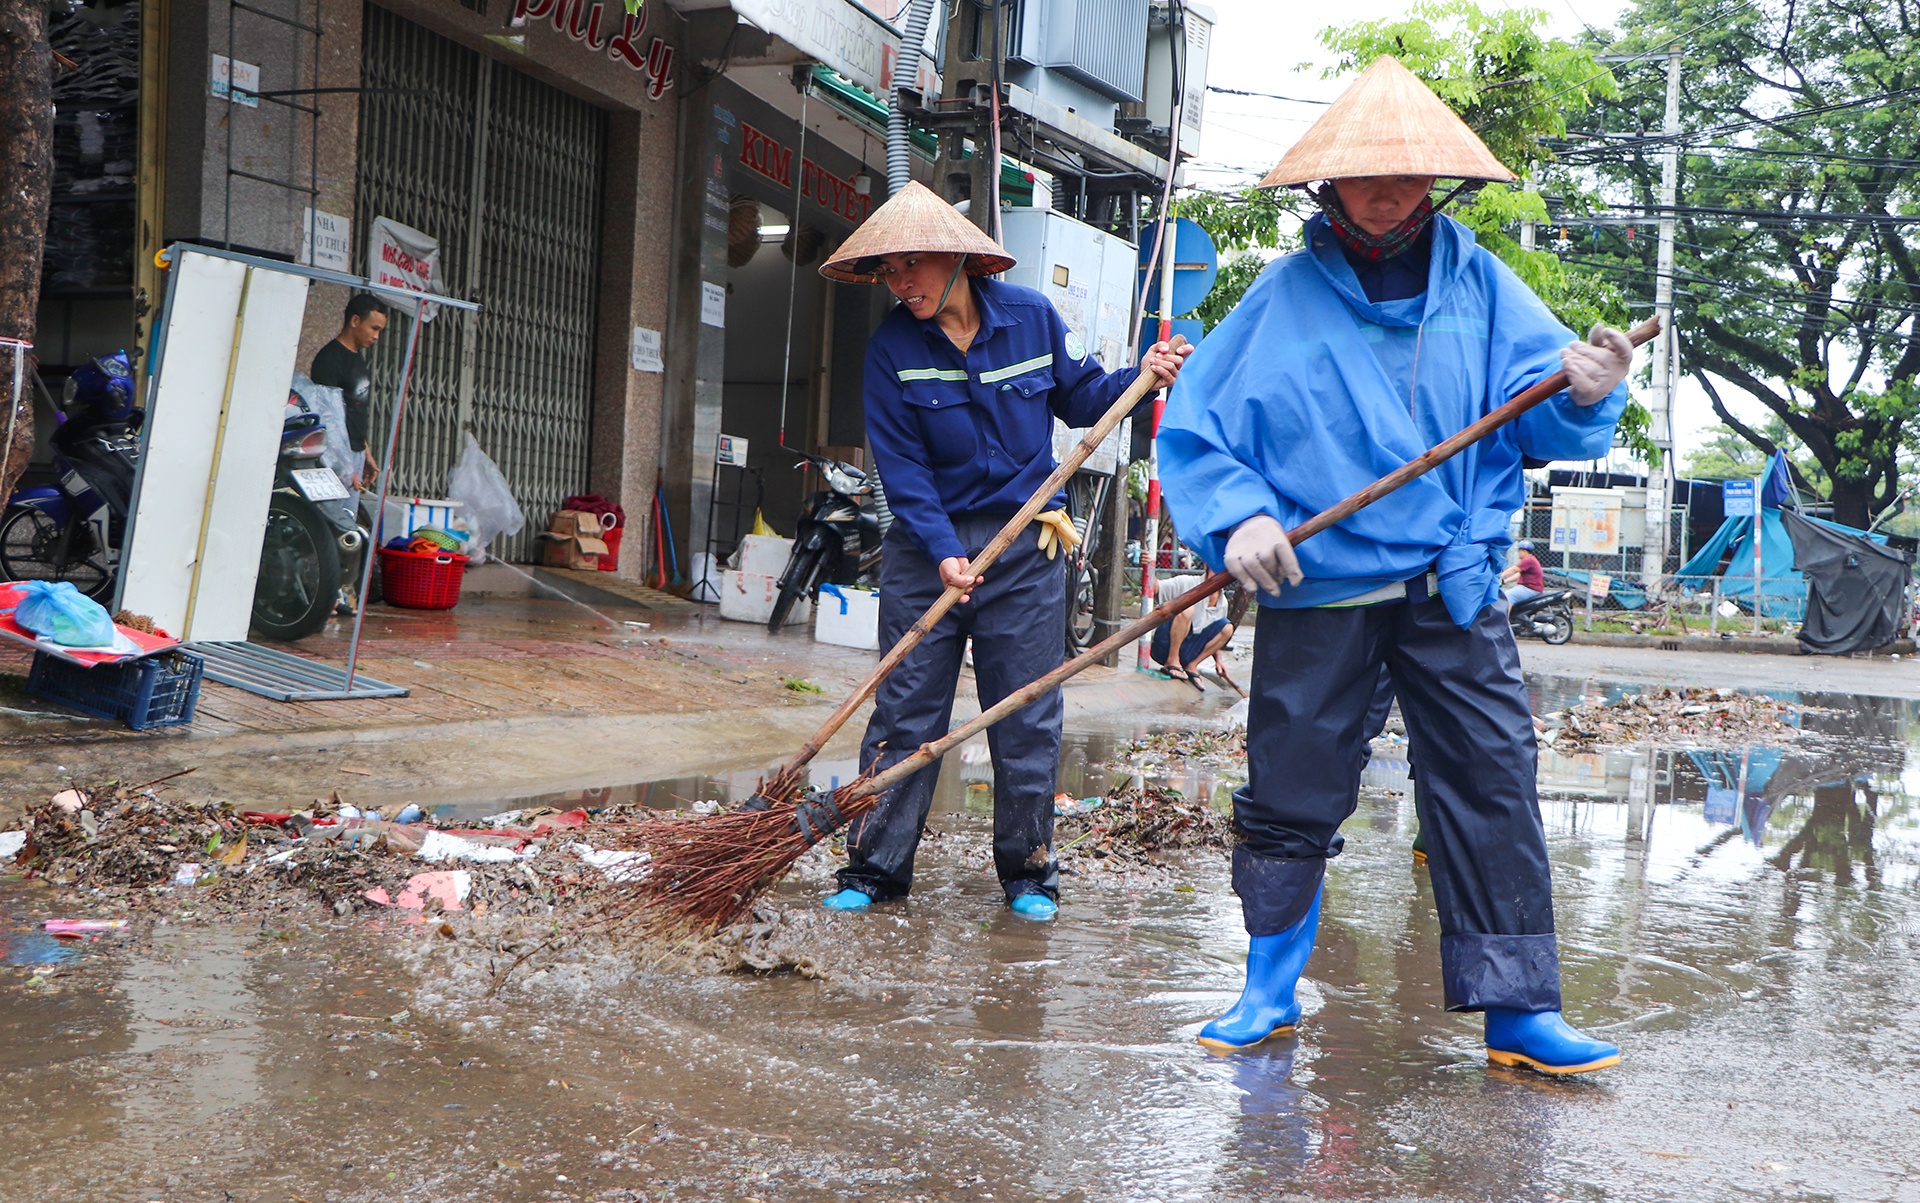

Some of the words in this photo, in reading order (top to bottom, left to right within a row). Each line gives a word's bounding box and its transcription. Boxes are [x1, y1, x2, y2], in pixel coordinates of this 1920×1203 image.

[811, 7, 836, 52] MỸ
[836, 18, 875, 78] PHẨM
[740, 121, 794, 190] KIM
[802, 157, 873, 224] TUYẾT
[304, 231, 323, 248] CO
[324, 236, 348, 254] THUÊ
